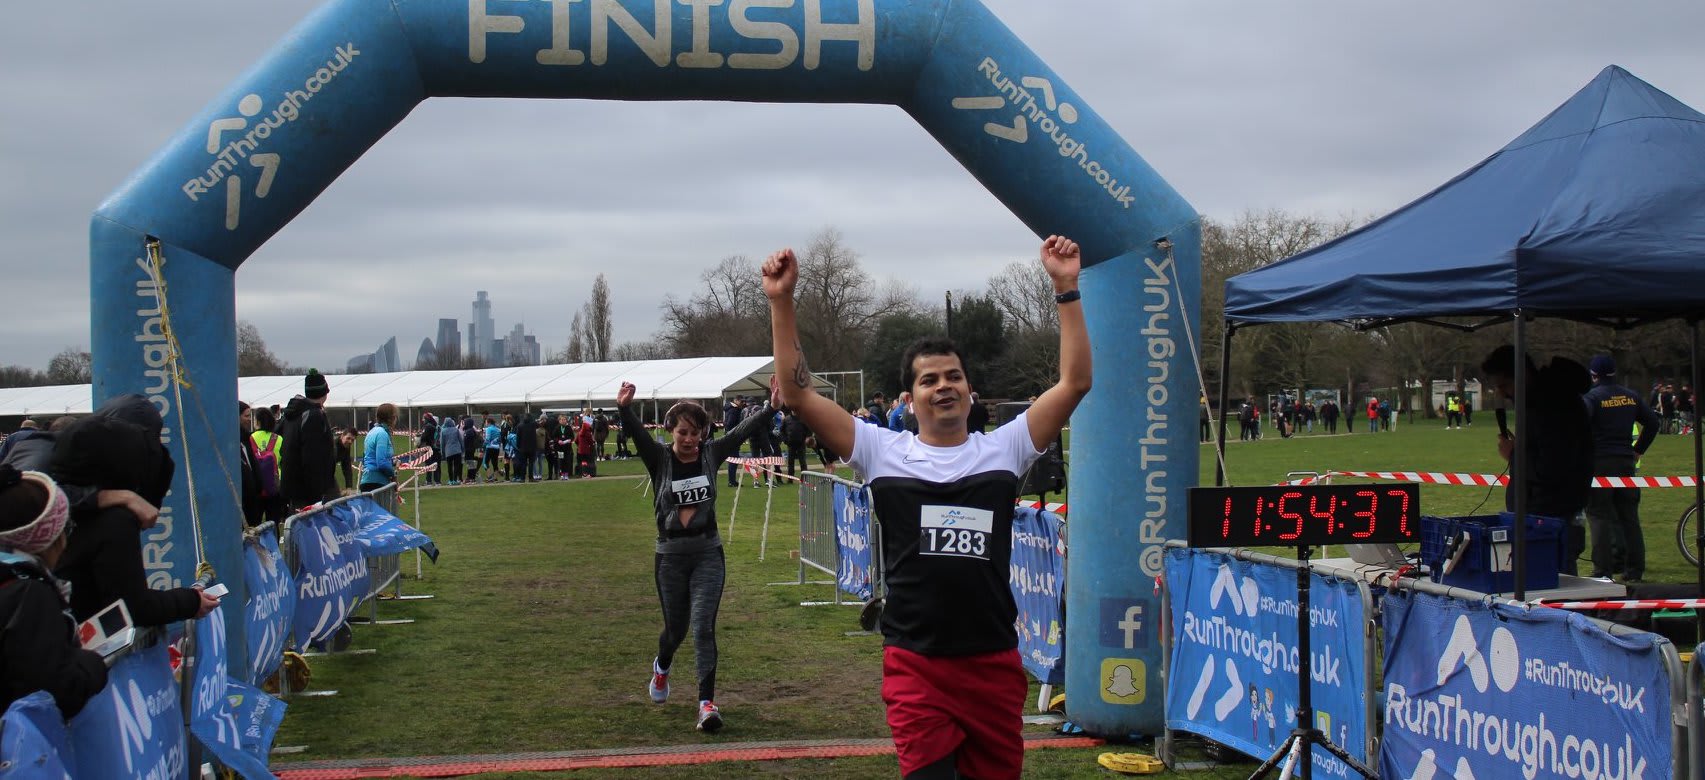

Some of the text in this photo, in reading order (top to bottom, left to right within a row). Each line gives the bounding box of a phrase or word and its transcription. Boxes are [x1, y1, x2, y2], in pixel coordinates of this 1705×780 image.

[468, 0, 876, 71] FINISH
[182, 42, 361, 201] RunThrough.co.uk
[977, 56, 1135, 208] RunThrough.co.uk
[1138, 257, 1176, 577] @RunThroughUK
[1601, 398, 1637, 408] MEDICAL
[676, 487, 708, 504] 1212
[928, 528, 986, 555] 1283
